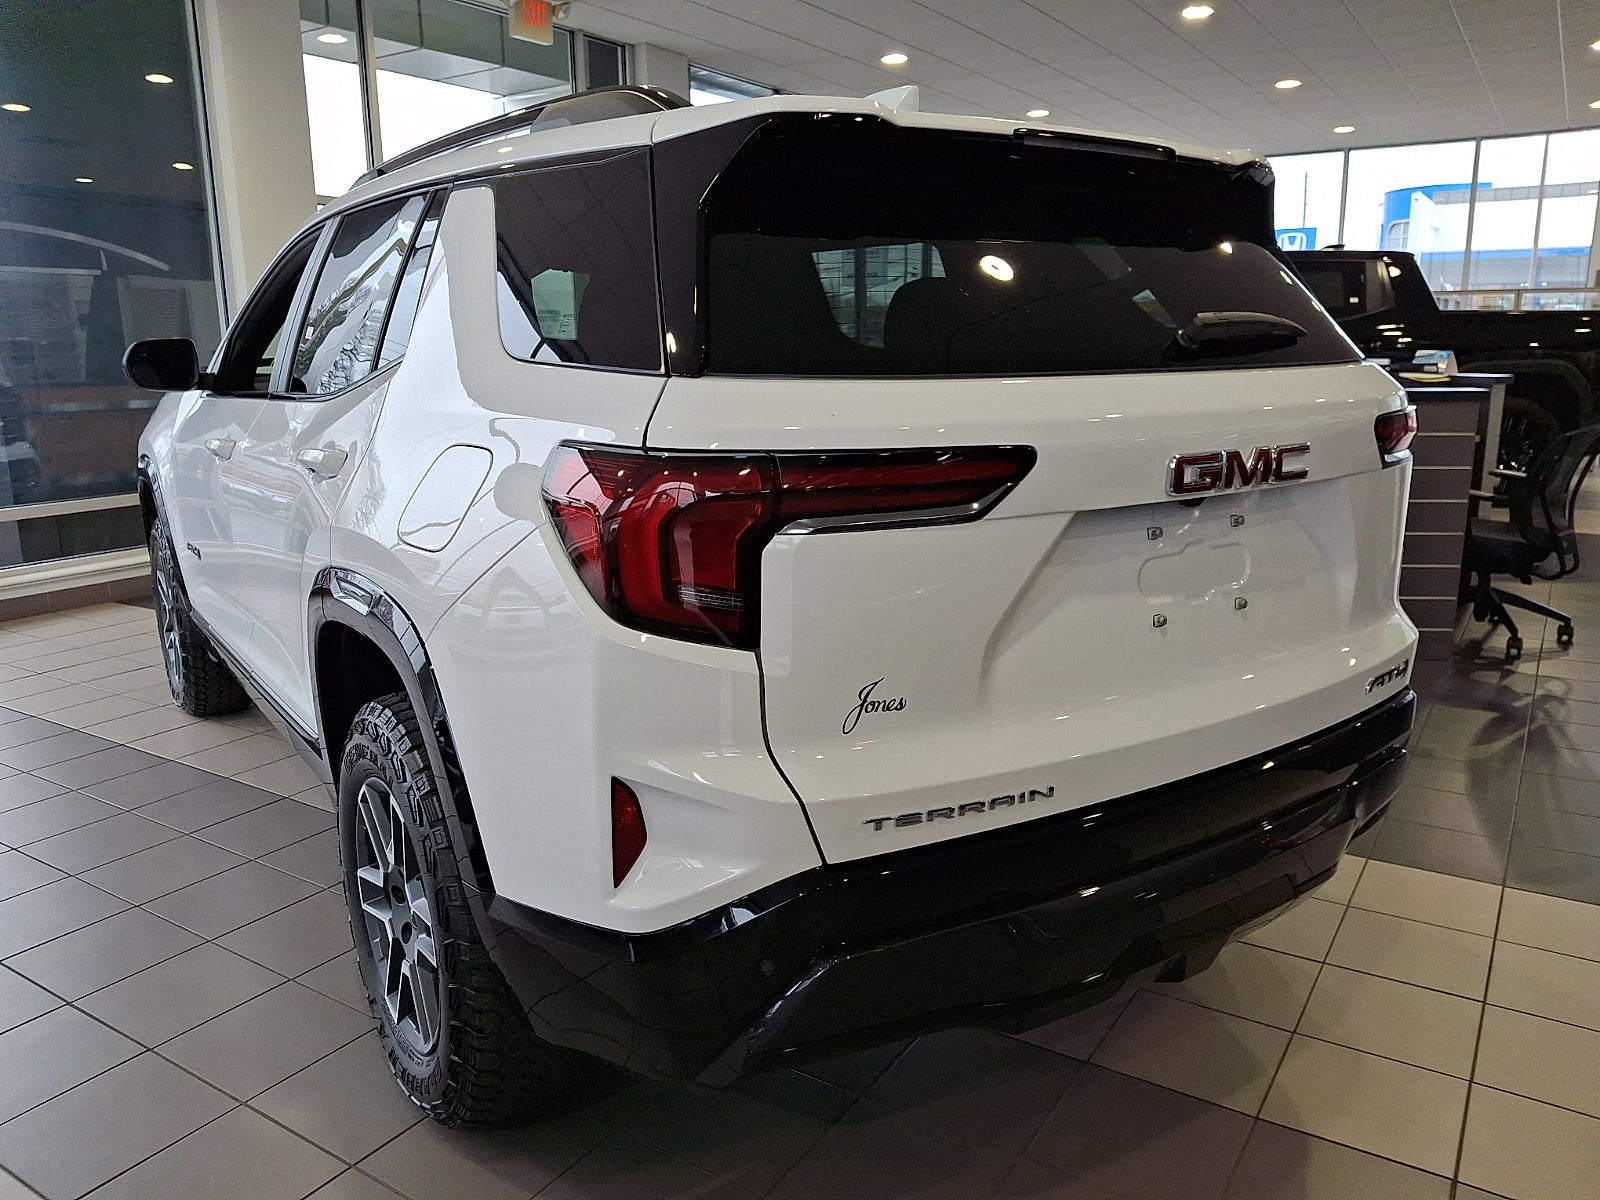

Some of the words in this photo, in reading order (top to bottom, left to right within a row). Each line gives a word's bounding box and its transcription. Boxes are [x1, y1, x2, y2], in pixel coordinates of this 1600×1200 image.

[522, 0, 547, 29] EXIT
[1166, 442, 1311, 496] GMC
[1365, 659, 1409, 694] AT4
[842, 677, 907, 735] Jones
[862, 785, 1055, 831] TERRAIN
